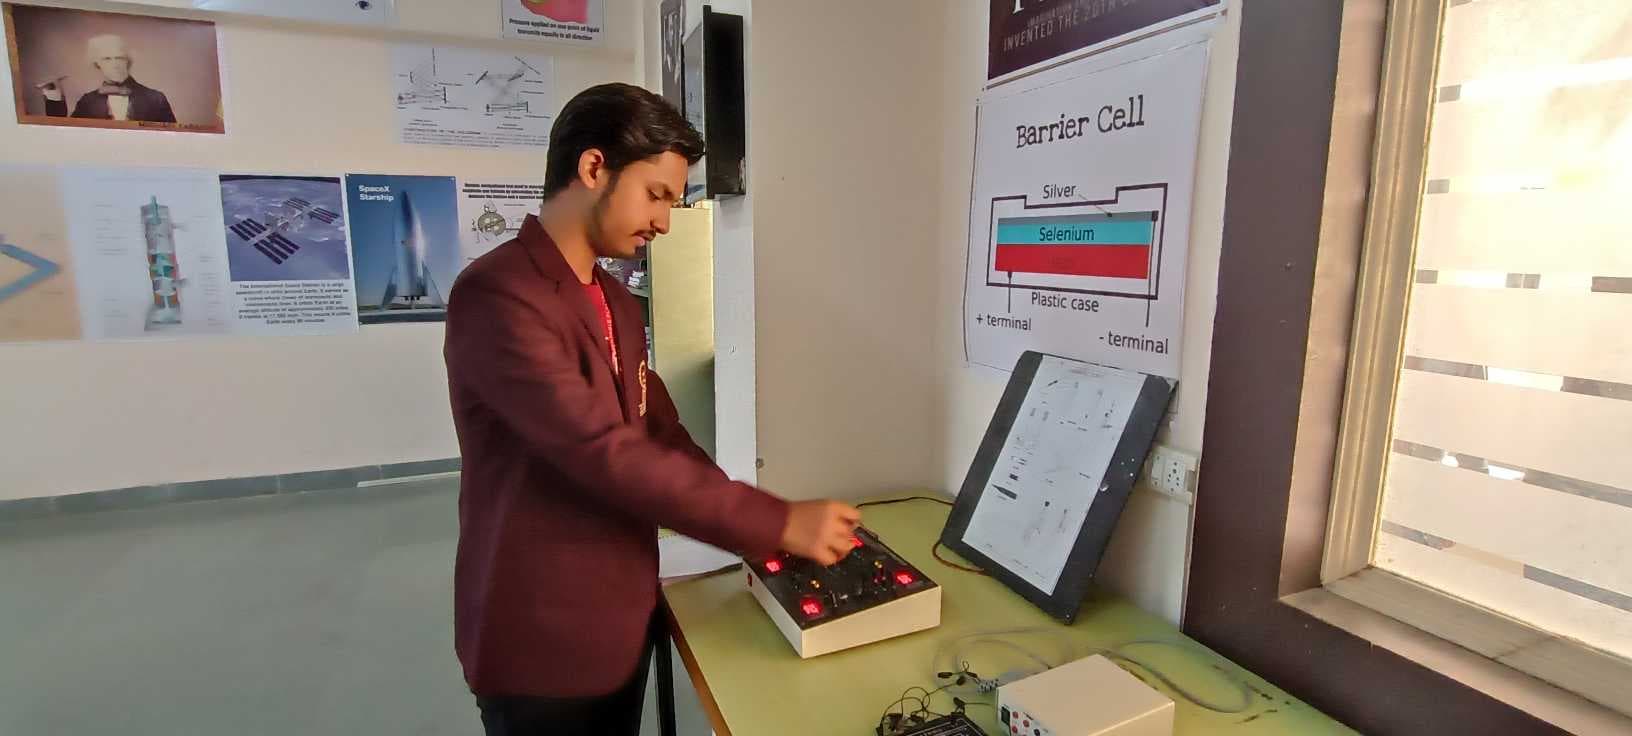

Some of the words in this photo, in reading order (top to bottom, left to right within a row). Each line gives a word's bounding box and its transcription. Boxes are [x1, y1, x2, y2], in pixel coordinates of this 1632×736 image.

[1003, 20, 1053, 52] INVENTED
[1058, 10, 1079, 33] THE
[1016, 113, 1089, 149] Barrier
[1097, 94, 1144, 133] Cell
[359, 185, 390, 193] SpaceX
[360, 194, 394, 202] Starship
[1043, 184, 1076, 199] Silver
[1039, 225, 1095, 241] Selenium
[1031, 291, 1067, 309] Plastic
[1071, 297, 1099, 312] case
[987, 313, 1032, 331] terminal
[1108, 330, 1169, 355] terminal
